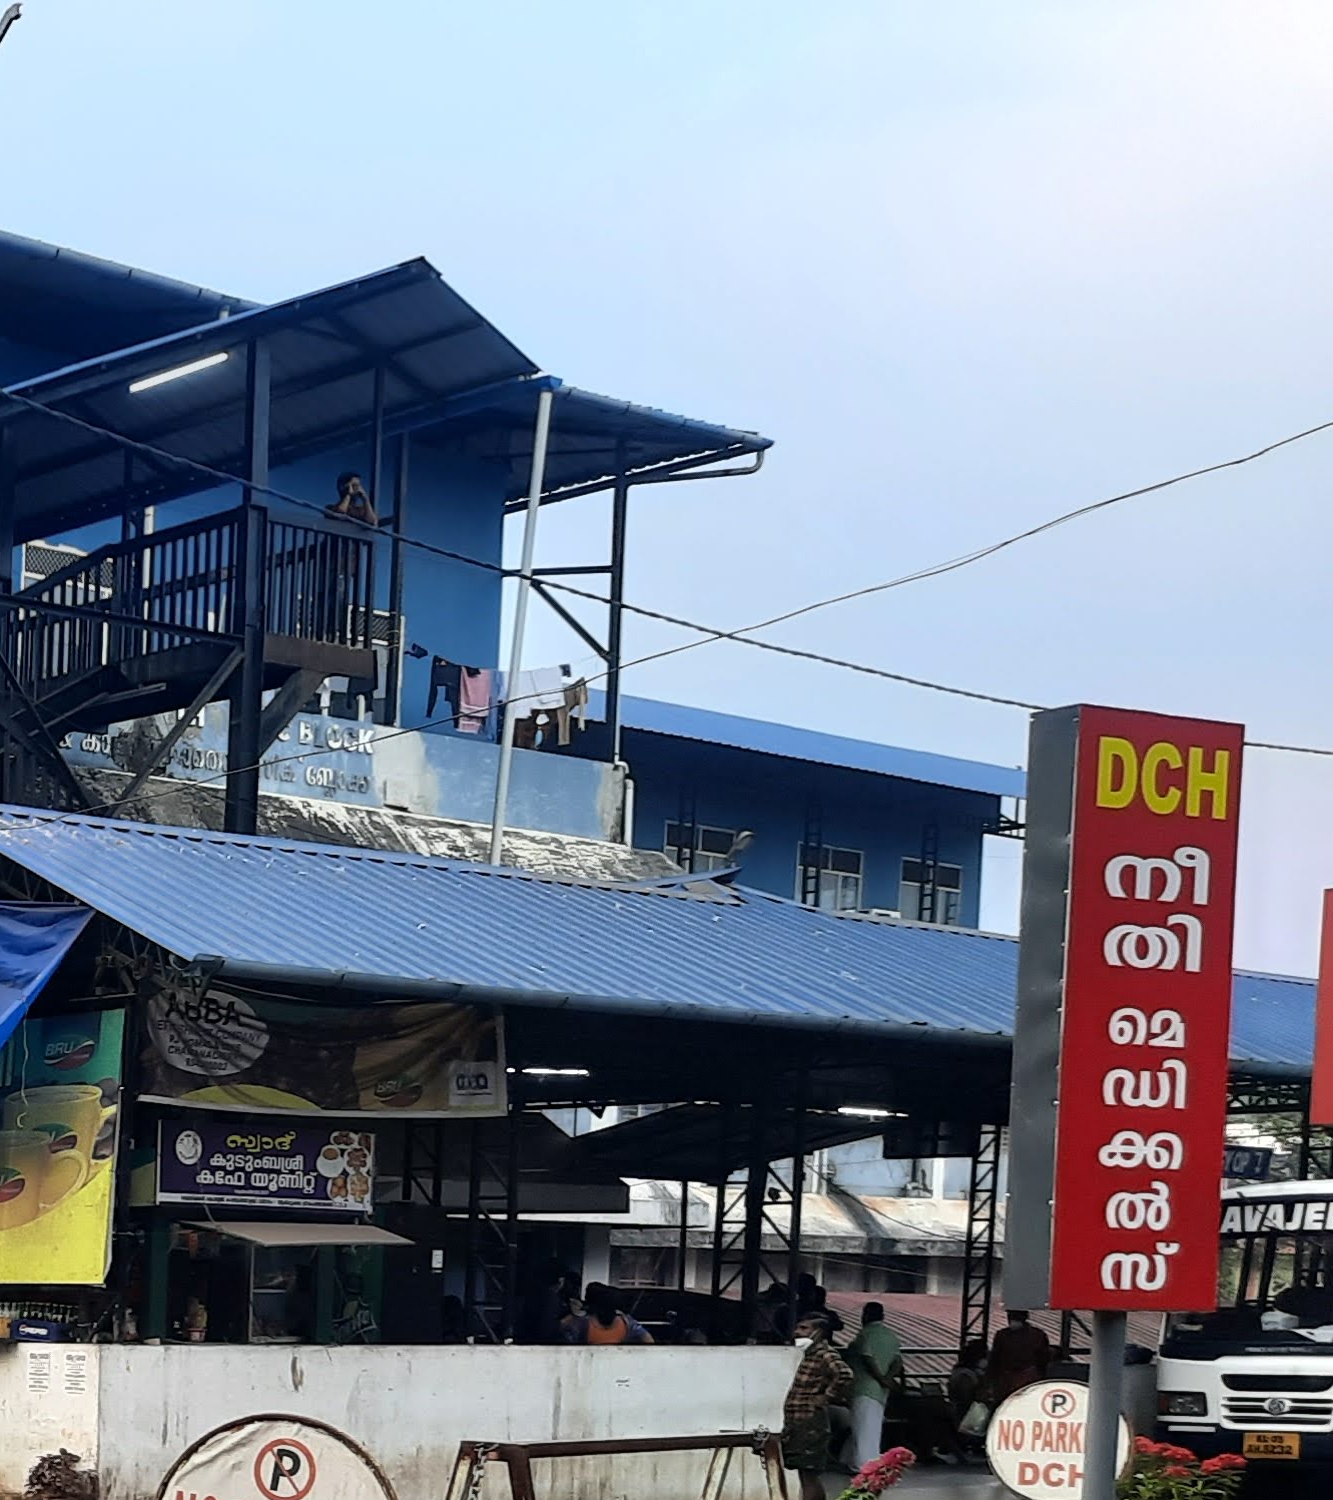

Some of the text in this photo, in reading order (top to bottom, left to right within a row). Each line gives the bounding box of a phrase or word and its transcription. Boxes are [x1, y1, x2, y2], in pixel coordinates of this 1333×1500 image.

[1096, 735, 1231, 821] DCH
[1103, 845, 1211, 973] നീതി
[45, 1042, 74, 1057] BRU
[1098, 1006, 1188, 1292] മെഡിക്കൽസ്
[997, 1419, 1085, 1454] NO PARK
